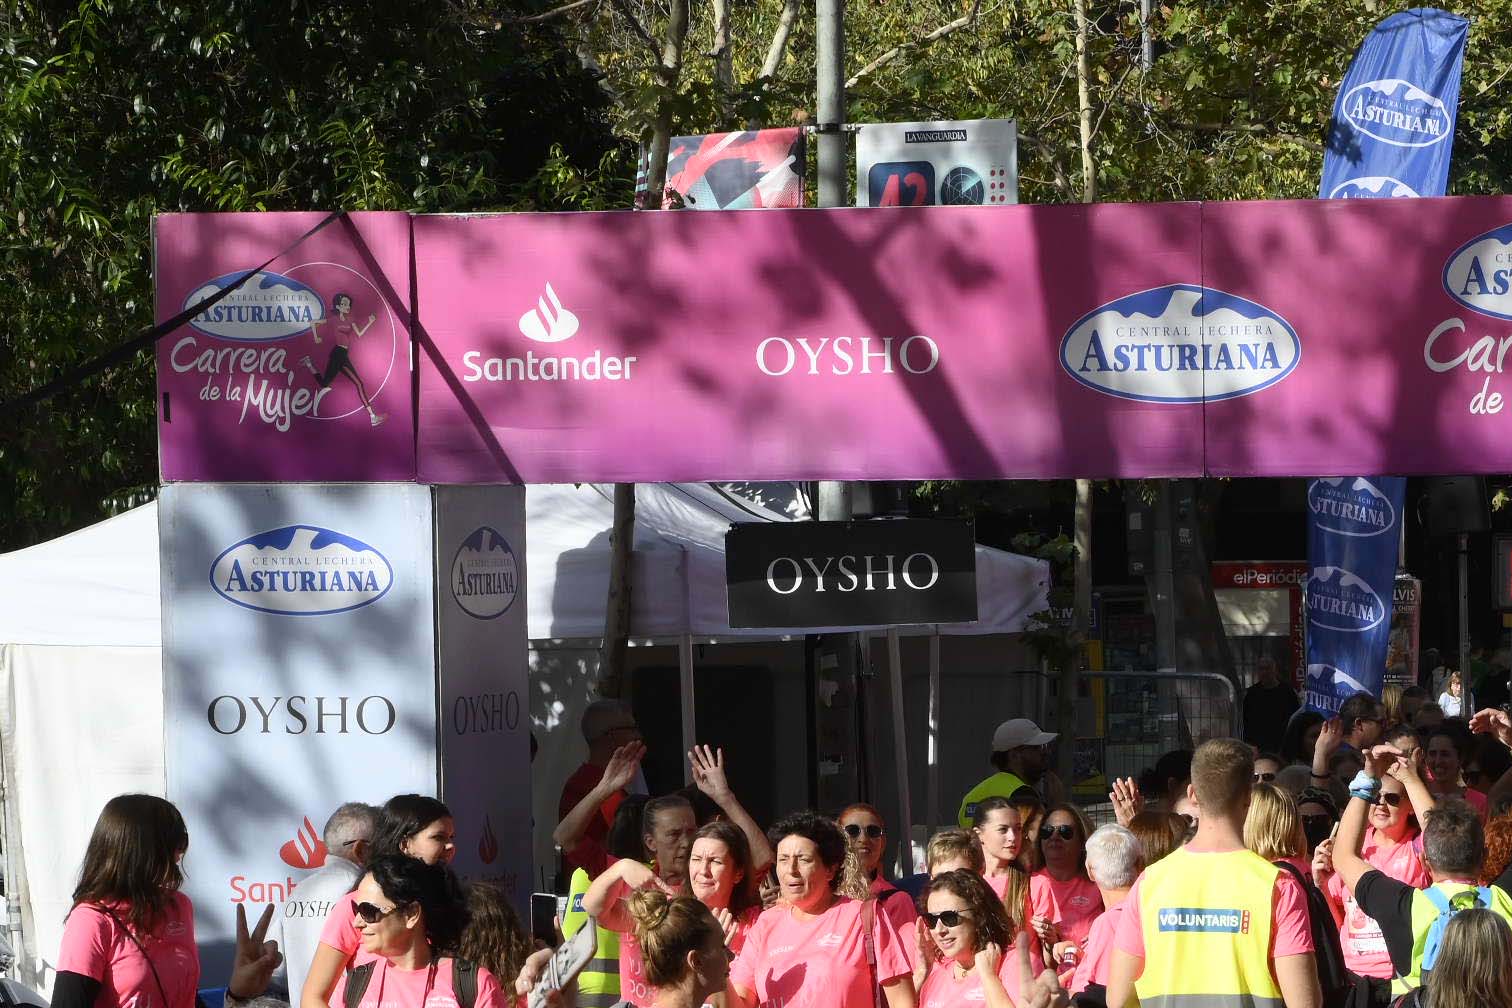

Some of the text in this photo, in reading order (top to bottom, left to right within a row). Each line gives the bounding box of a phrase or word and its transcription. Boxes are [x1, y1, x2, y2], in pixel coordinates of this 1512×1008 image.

[1116, 323, 1274, 338] CENTRAL LECHERA
[170, 337, 287, 374] Carrera
[463, 351, 637, 381] Santander
[756, 336, 940, 376] OYSHO
[1078, 329, 1282, 373] ASTURIANA
[200, 371, 332, 432] de la Mujer
[1469, 377, 1503, 414] de
[224, 558, 381, 593] ASTURIANA
[252, 556, 312, 567] CENTRAL
[456, 561, 515, 598] ASTURIANA
[766, 553, 940, 595] OYSHO
[207, 695, 397, 736] OYSHO
[453, 691, 521, 736] OYSHO
[1160, 914, 1239, 928] VOLUNTARIS
